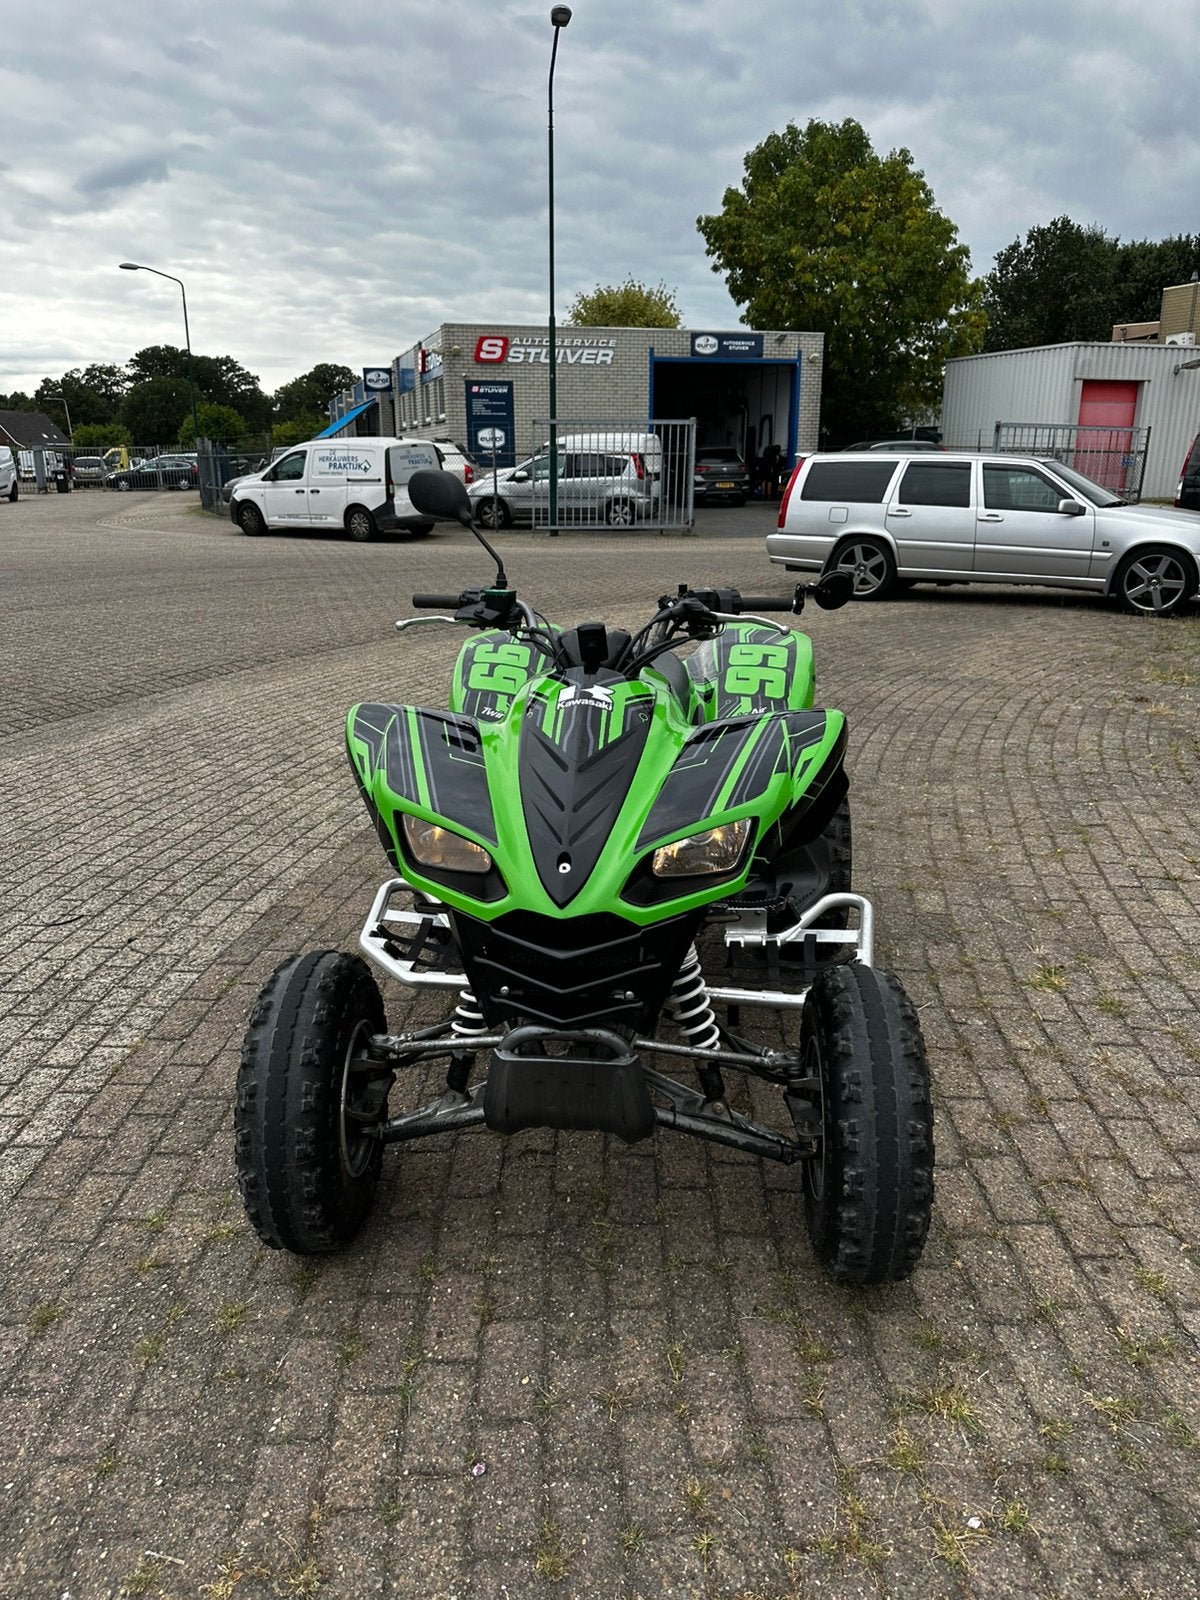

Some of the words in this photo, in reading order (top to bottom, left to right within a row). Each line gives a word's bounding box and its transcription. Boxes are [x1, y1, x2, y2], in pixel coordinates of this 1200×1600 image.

[511, 337, 617, 347] AUTOSERVICE
[507, 348, 614, 364] STUIVER
[328, 462, 363, 471] PRAKTIJK
[556, 698, 613, 711] Kawasaki
